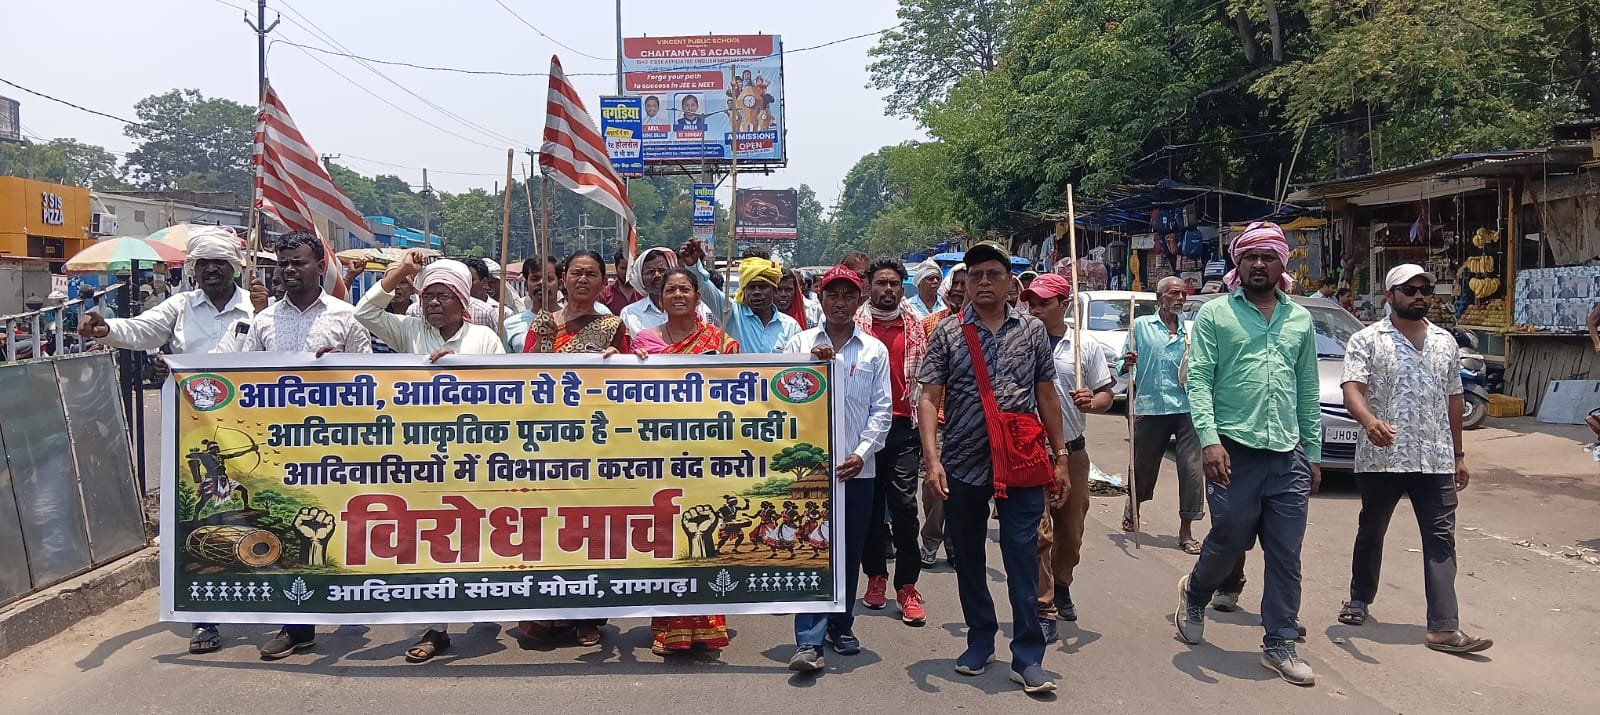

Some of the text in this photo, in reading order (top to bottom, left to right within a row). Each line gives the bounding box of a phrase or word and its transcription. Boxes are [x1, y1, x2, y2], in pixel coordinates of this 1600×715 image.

[640, 47, 757, 58] CHAITANYA'S ACADEMY
[739, 141, 763, 150] OPEN
[42, 191, 63, 209] 3 SIS
[42, 208, 64, 225] PIZZA
[239, 375, 385, 410] आदिवासी,
[393, 374, 525, 407] आदिकाल
[531, 372, 556, 405] से
[561, 371, 582, 407] है
[605, 372, 704, 404] वनवासी
[267, 414, 395, 448] आदिवासी
[402, 413, 511, 453] प्राकृतिक
[516, 419, 586, 453] पूजक
[591, 411, 609, 444] है
[637, 411, 735, 441] सनातनी
[1333, 430, 1358, 441] JH09
[283, 454, 449, 486] आदिवासियों
[454, 453, 481, 482] में
[486, 452, 591, 482] विभाजन
[597, 455, 664, 481] करना
[671, 451, 703, 480] बंद
[340, 487, 684, 567] विरोध मार्च
[326, 576, 459, 602] आदिवासी
[464, 574, 534, 600] संघर्ष
[538, 573, 605, 599] मोर्चा,
